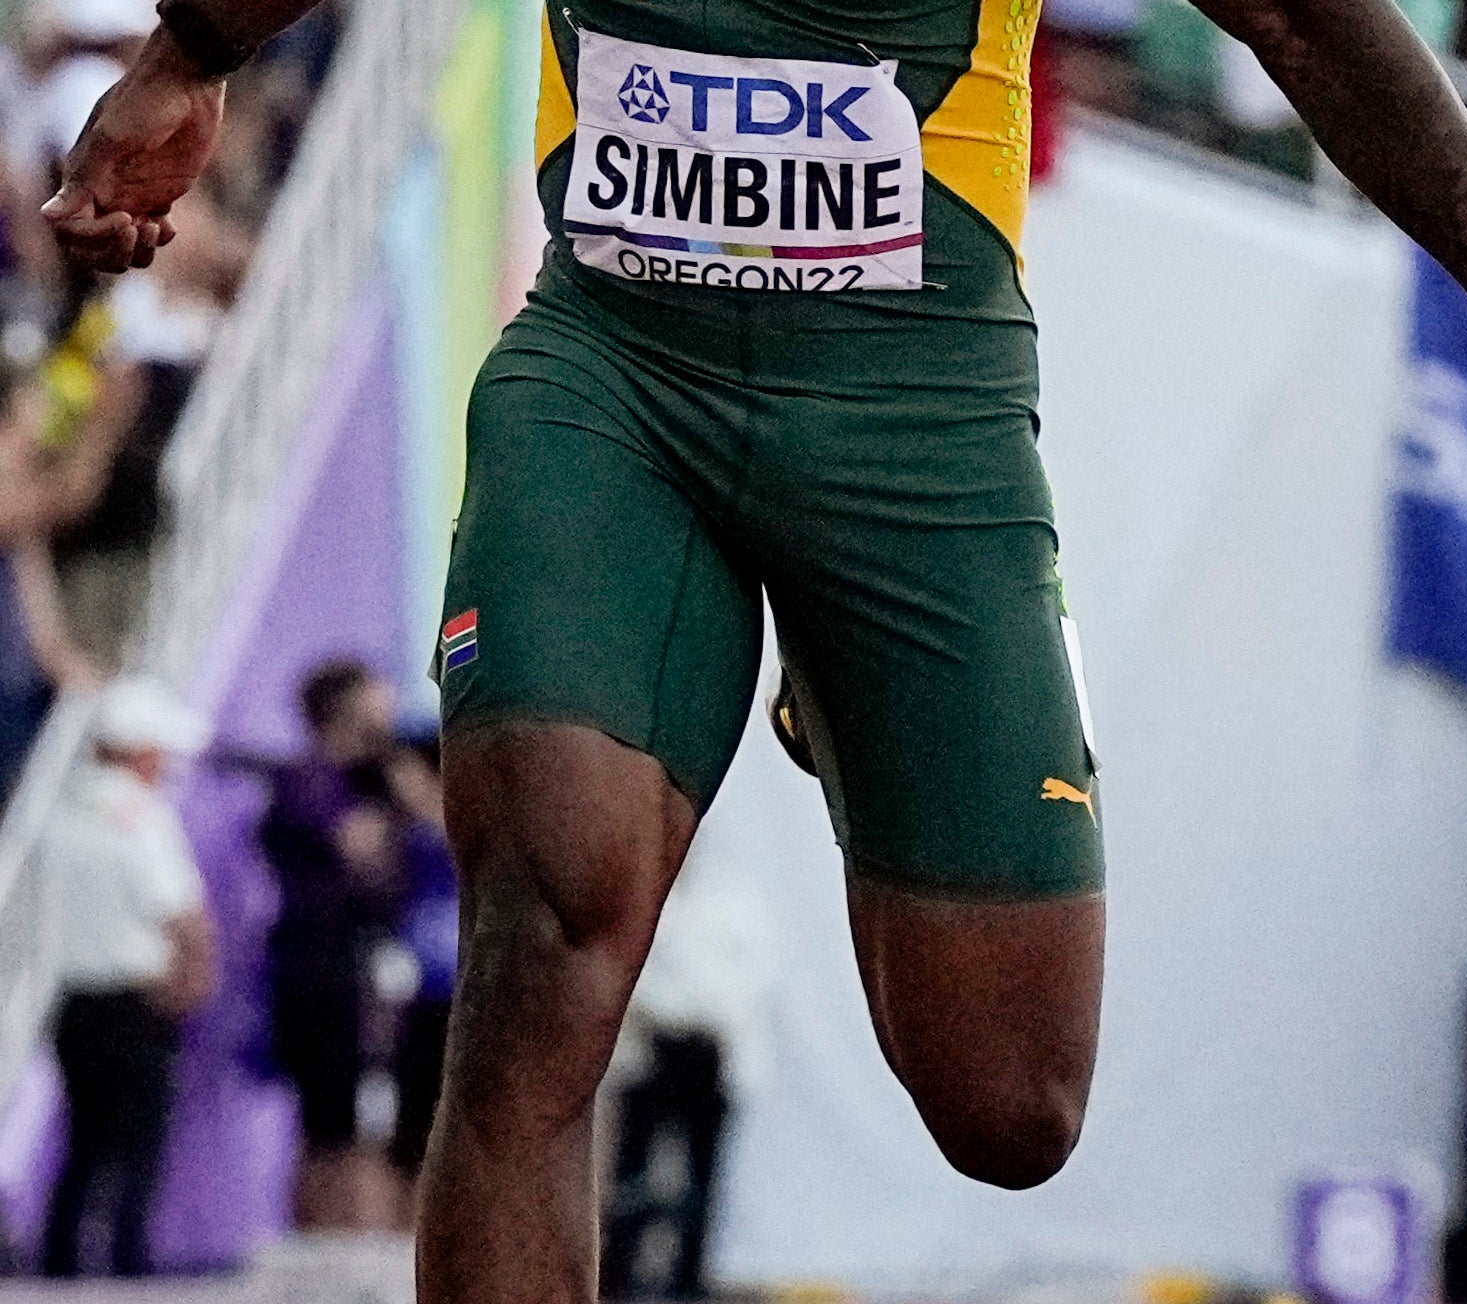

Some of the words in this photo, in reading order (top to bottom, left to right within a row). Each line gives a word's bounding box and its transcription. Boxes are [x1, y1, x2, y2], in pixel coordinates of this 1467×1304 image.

[667, 72, 872, 142] TDK
[588, 135, 900, 231] SIMBINE
[618, 249, 864, 291] OREGON22
